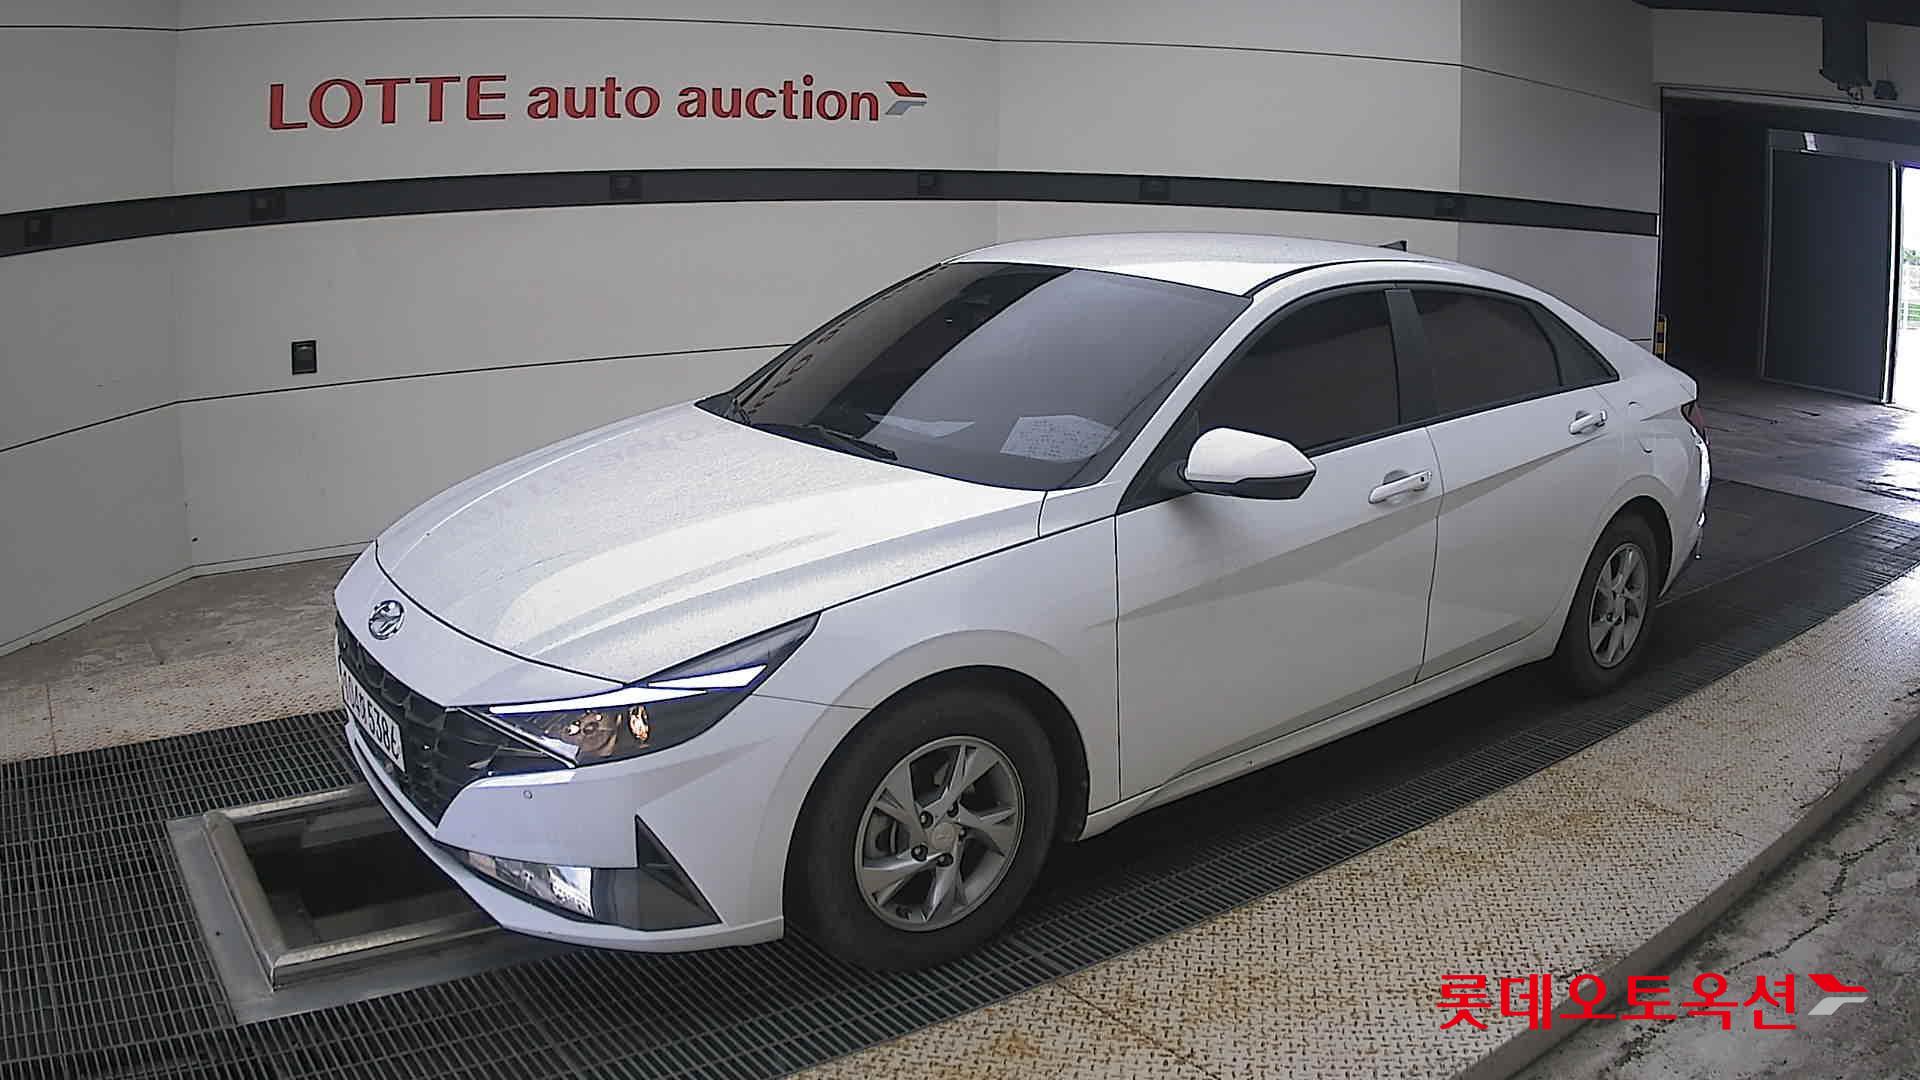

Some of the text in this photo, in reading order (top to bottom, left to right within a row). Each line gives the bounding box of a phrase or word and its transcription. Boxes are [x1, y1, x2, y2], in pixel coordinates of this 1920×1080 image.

[269, 74, 879, 130] LOTTE auto auction
